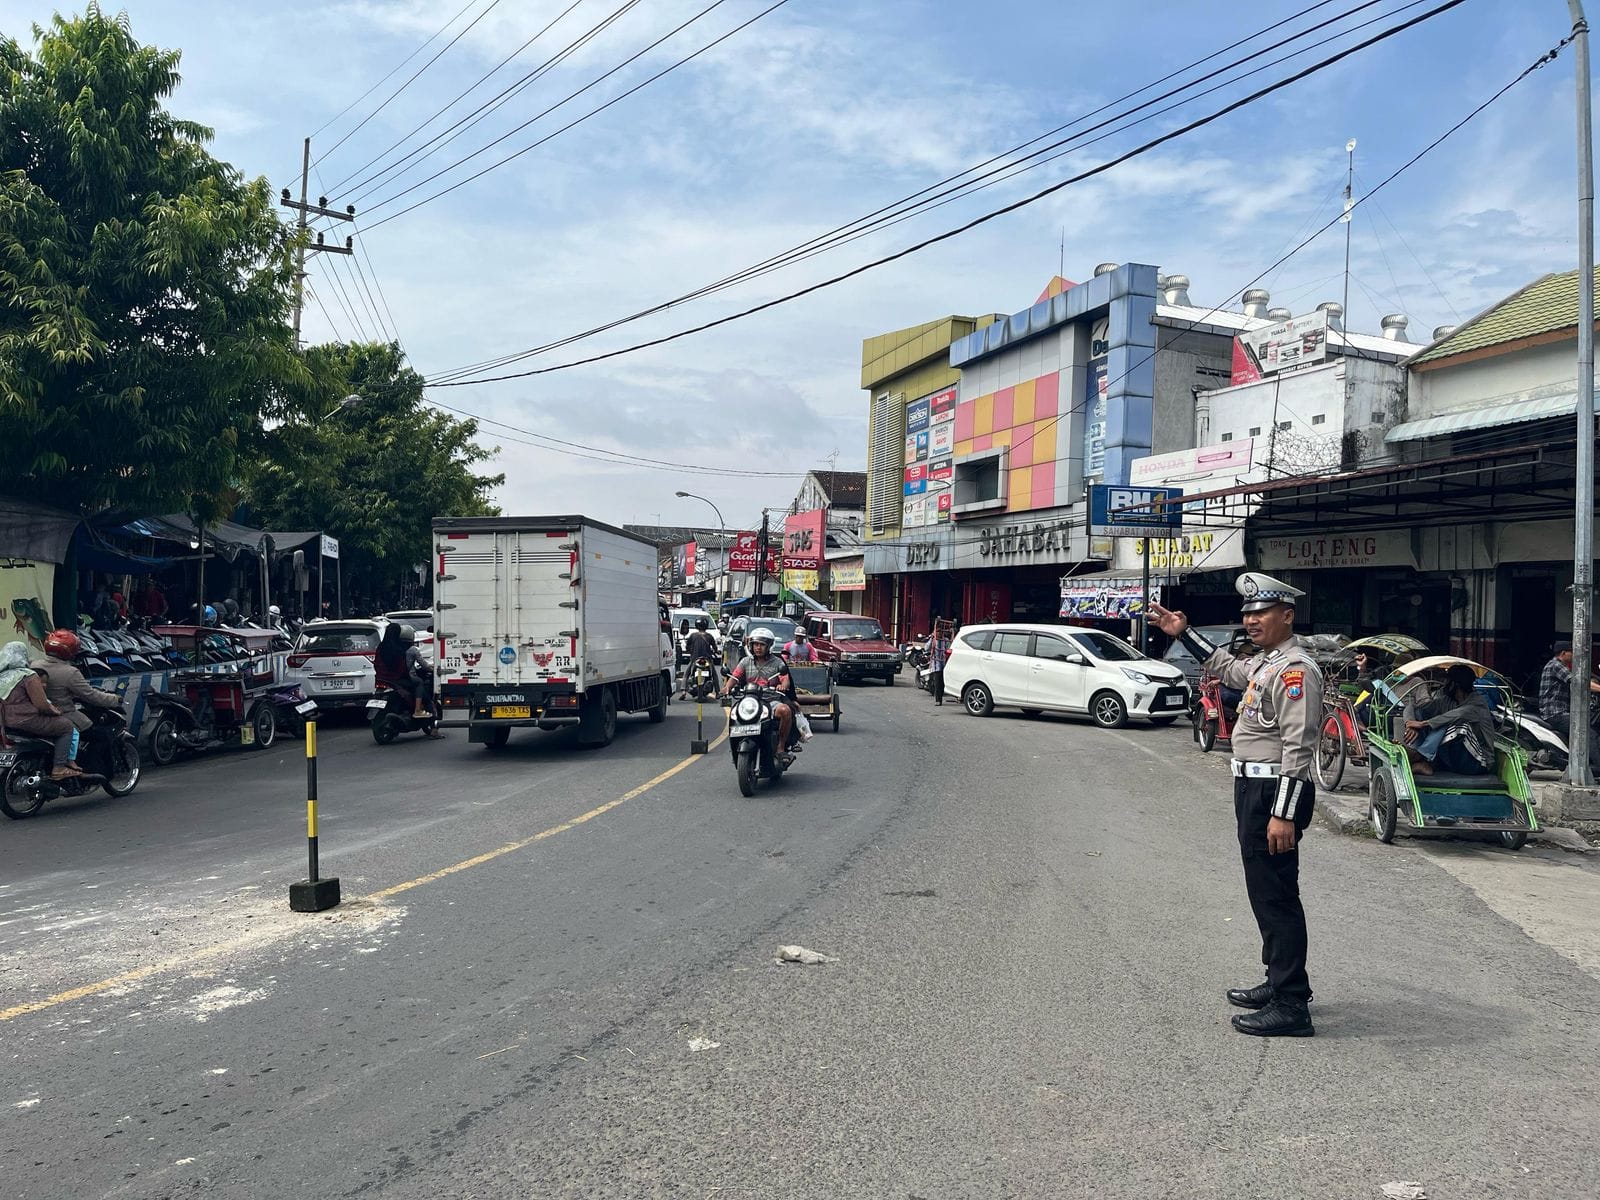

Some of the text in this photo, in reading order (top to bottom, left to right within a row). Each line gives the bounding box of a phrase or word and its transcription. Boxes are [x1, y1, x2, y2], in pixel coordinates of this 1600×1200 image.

[1139, 458, 1185, 474] HONDA
[1111, 491, 1165, 514] BM1
[980, 522, 1071, 556] SAHABAT
[1103, 527, 1171, 537] SAHABAT MOTOR
[906, 541, 940, 566] DEPO
[1136, 533, 1213, 555] SAHABAT
[1287, 538, 1376, 558] LOTENG
[784, 558, 817, 568] STARS
[1152, 554, 1193, 568] MOTOR
